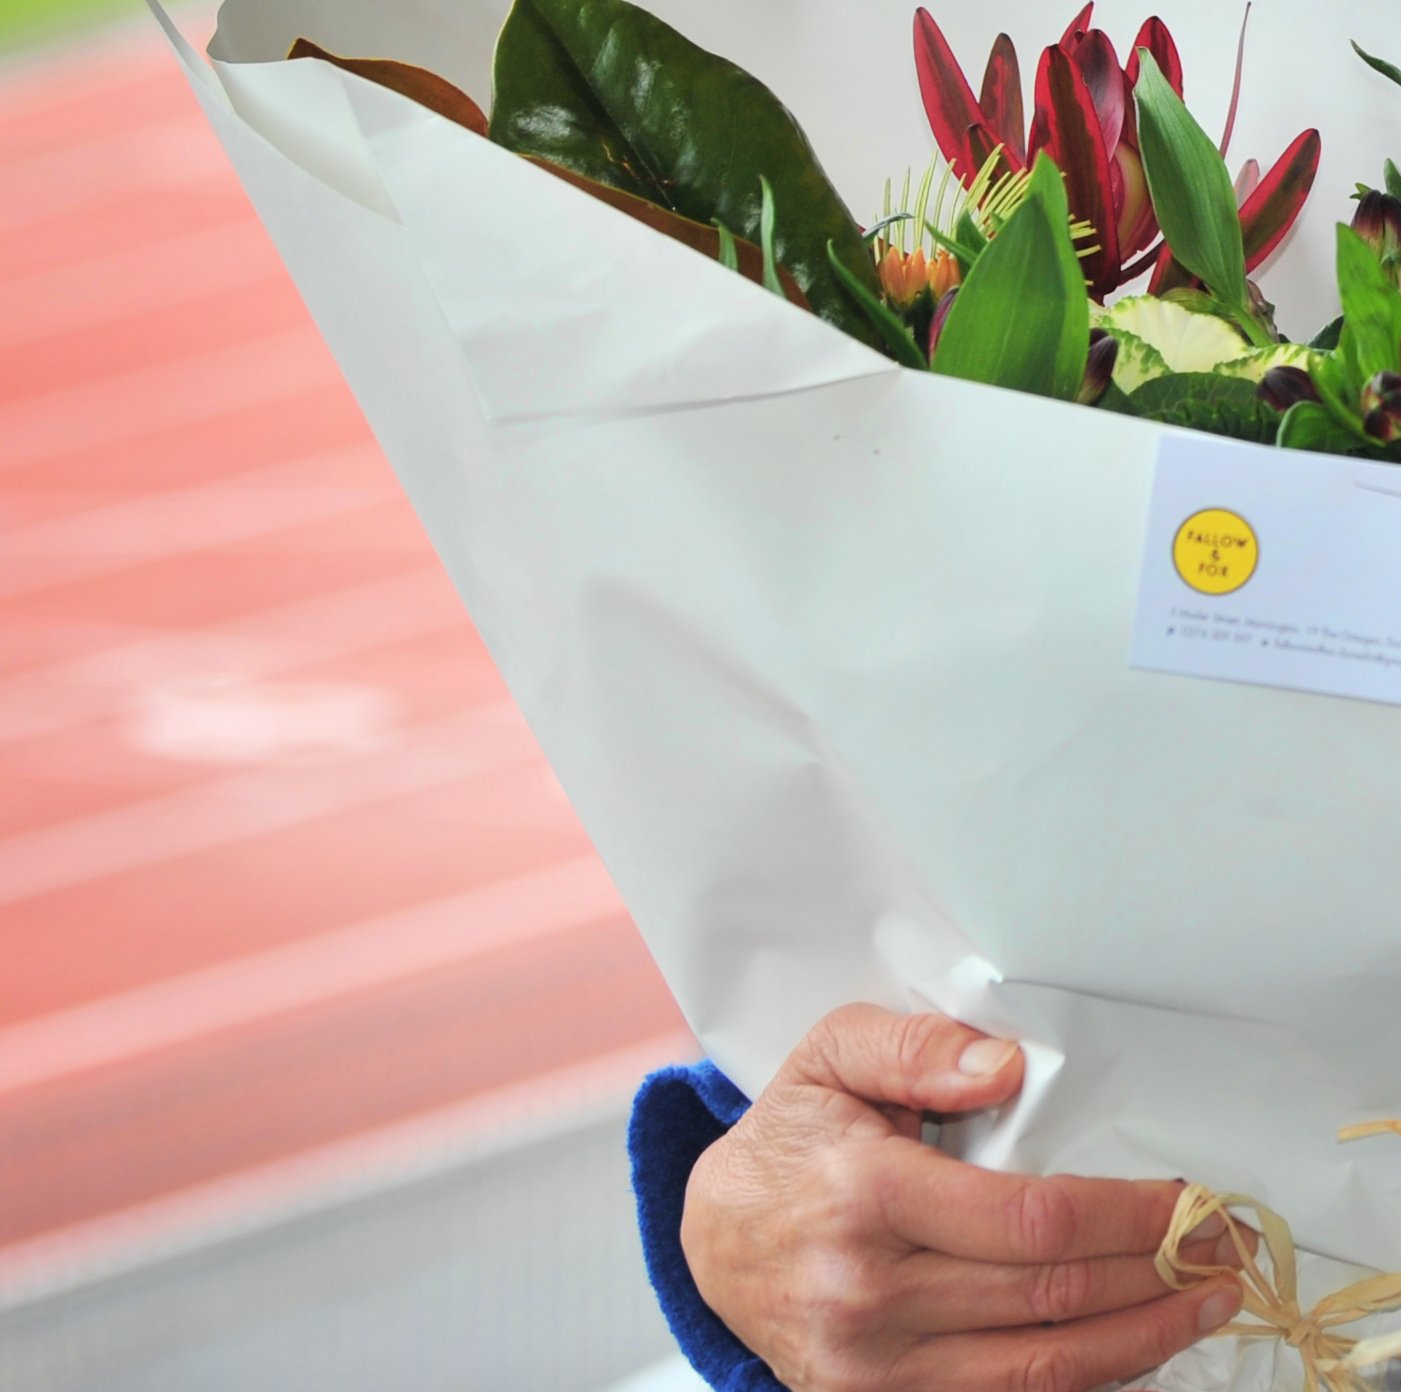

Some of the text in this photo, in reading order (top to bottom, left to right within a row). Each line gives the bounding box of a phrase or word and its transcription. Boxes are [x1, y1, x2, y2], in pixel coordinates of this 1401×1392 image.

[1187, 528, 1248, 549] FALLOW
[1211, 549, 1221, 562] &
[1198, 562, 1228, 577] FOX
